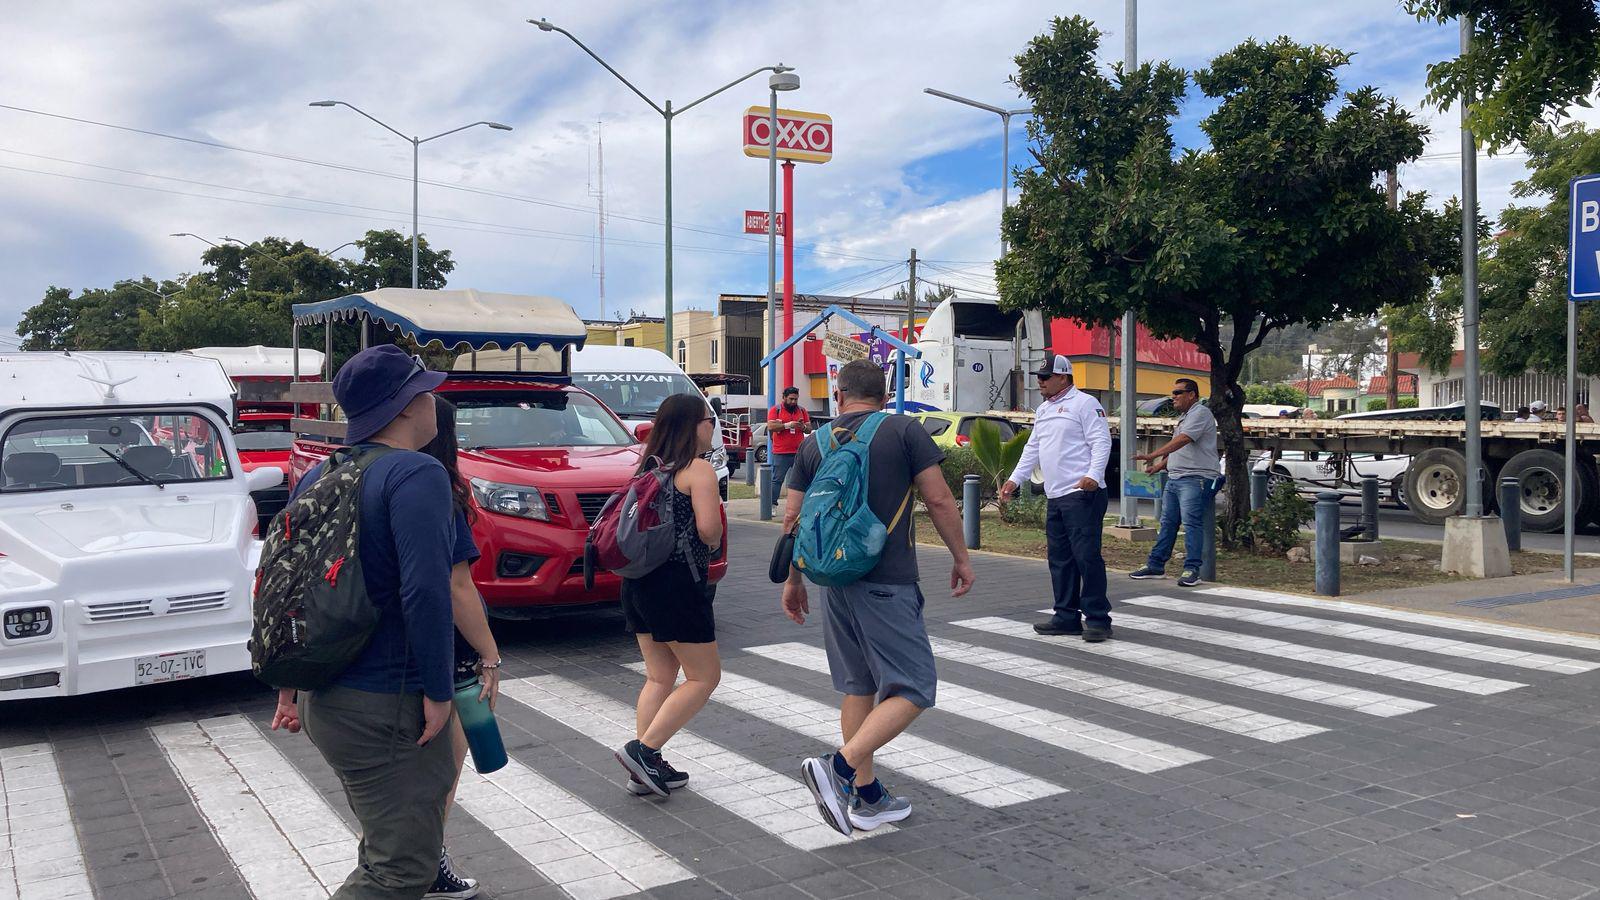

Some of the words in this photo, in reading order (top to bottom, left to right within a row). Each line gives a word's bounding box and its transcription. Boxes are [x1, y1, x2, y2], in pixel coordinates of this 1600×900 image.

[751, 117, 830, 151] OXXO
[584, 374, 673, 383] TAXIVAN
[137, 654, 204, 677] 52-07-TVC
